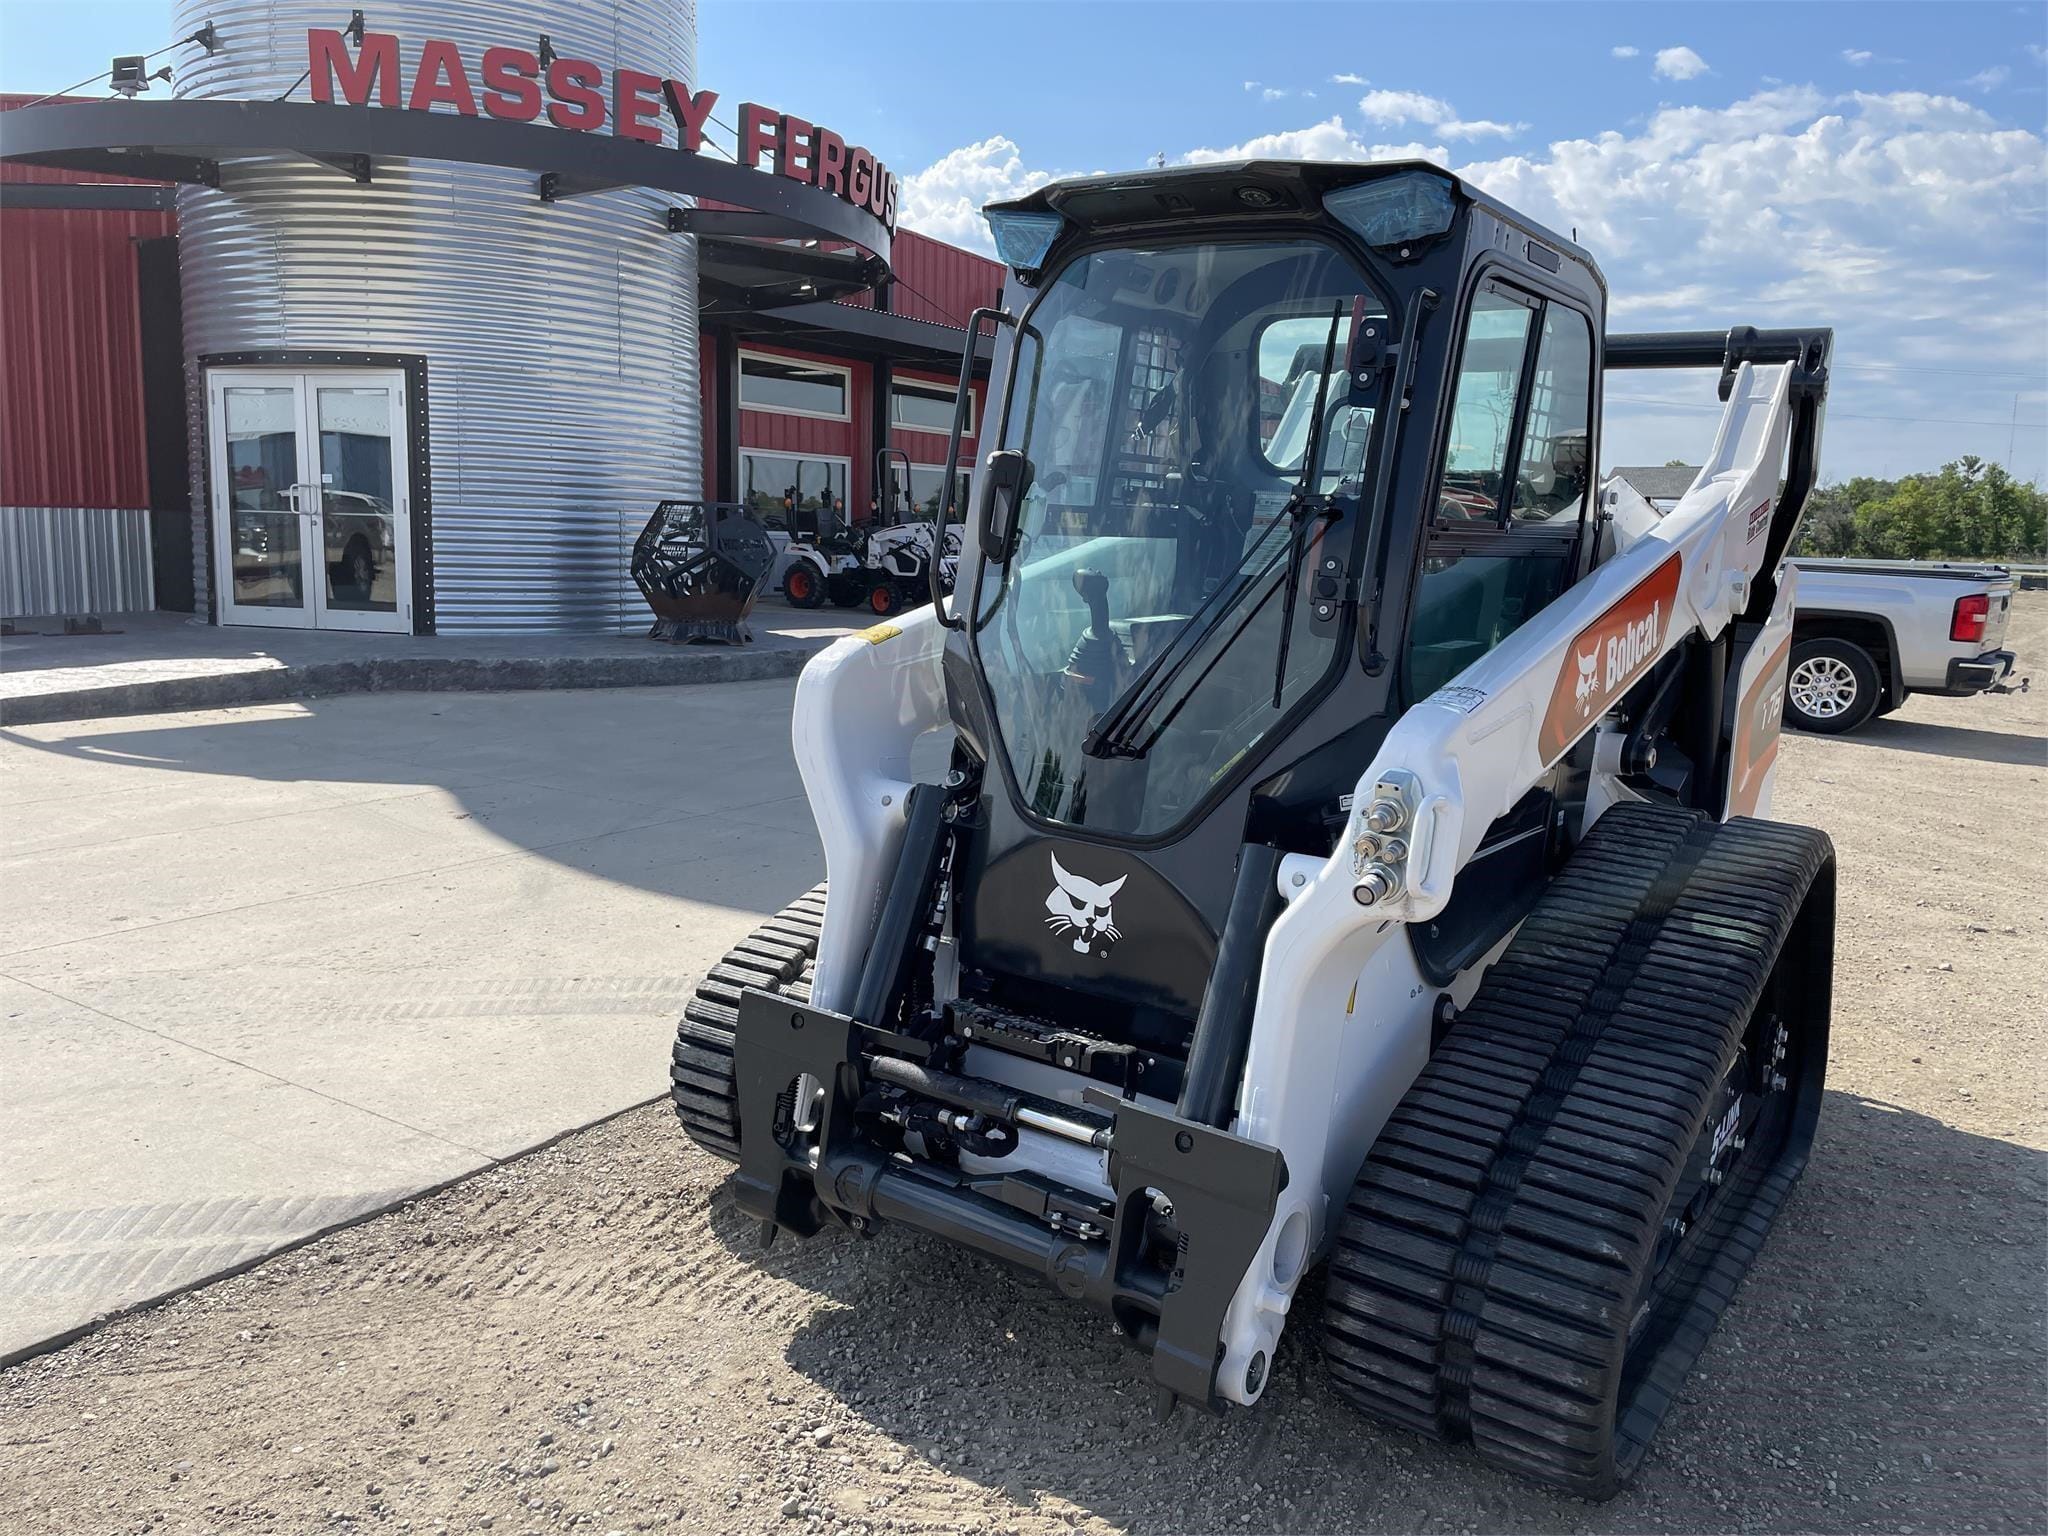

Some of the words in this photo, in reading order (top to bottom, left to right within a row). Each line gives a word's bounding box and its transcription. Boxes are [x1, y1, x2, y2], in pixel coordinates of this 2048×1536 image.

[307, 28, 719, 153] MASSEY
[738, 102, 898, 237] FERGUS
[1605, 599, 1660, 693] Bobcat
